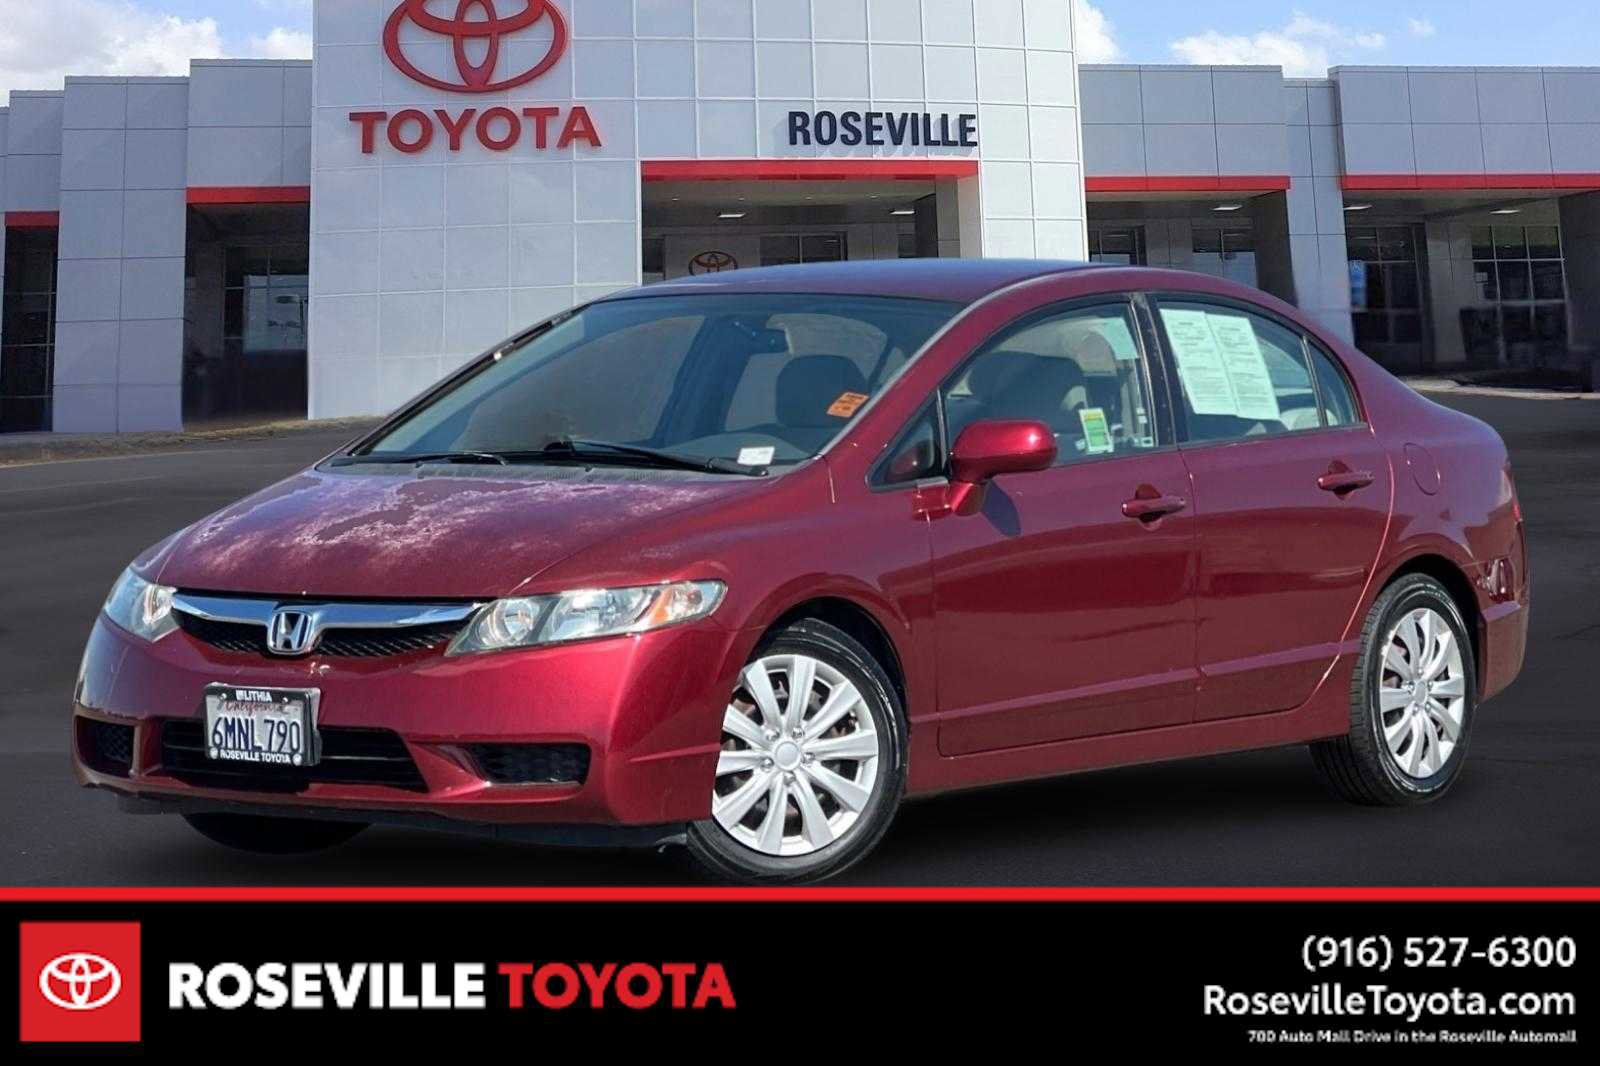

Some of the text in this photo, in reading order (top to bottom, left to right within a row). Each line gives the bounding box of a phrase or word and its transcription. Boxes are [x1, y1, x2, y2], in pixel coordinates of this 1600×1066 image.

[349, 105, 602, 154] TOYOTA
[789, 111, 978, 147] ROSEVILLE
[243, 690, 272, 702] LITHIA
[220, 749, 291, 764] ROSEVILLE TOYOTA
